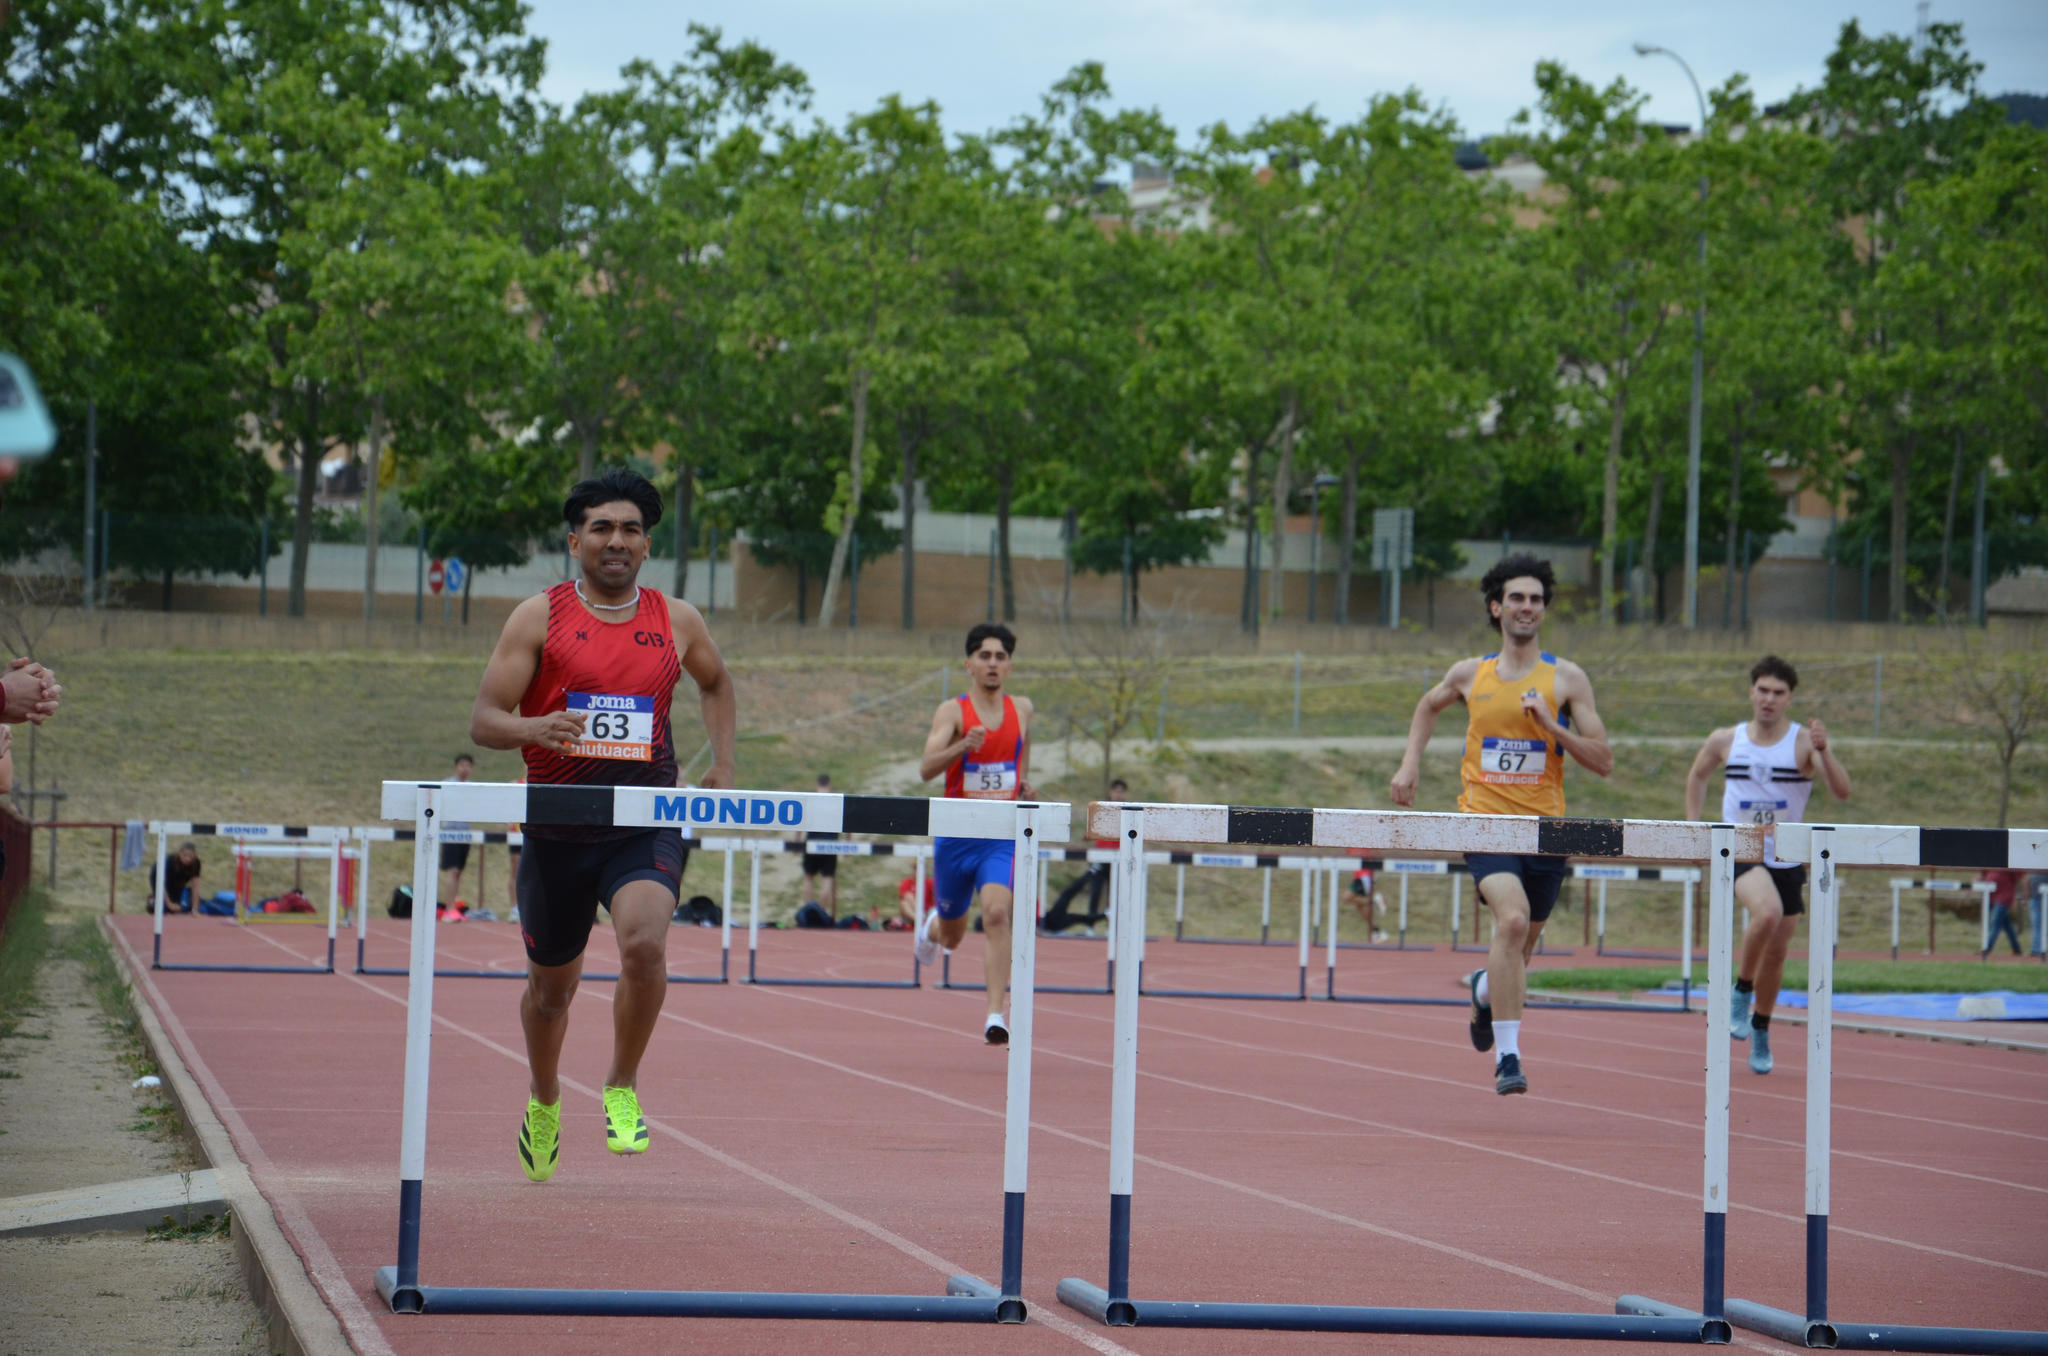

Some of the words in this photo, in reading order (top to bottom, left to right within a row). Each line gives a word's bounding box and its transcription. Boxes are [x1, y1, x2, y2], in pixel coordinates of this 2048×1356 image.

[592, 713, 630, 740] 63
[1499, 752, 1527, 772] 67
[980, 774, 1002, 790] 53
[654, 795, 803, 826] MONDO
[1753, 810, 1775, 826] 49
[224, 826, 268, 835] MONDO
[440, 832, 473, 841] ONDO
